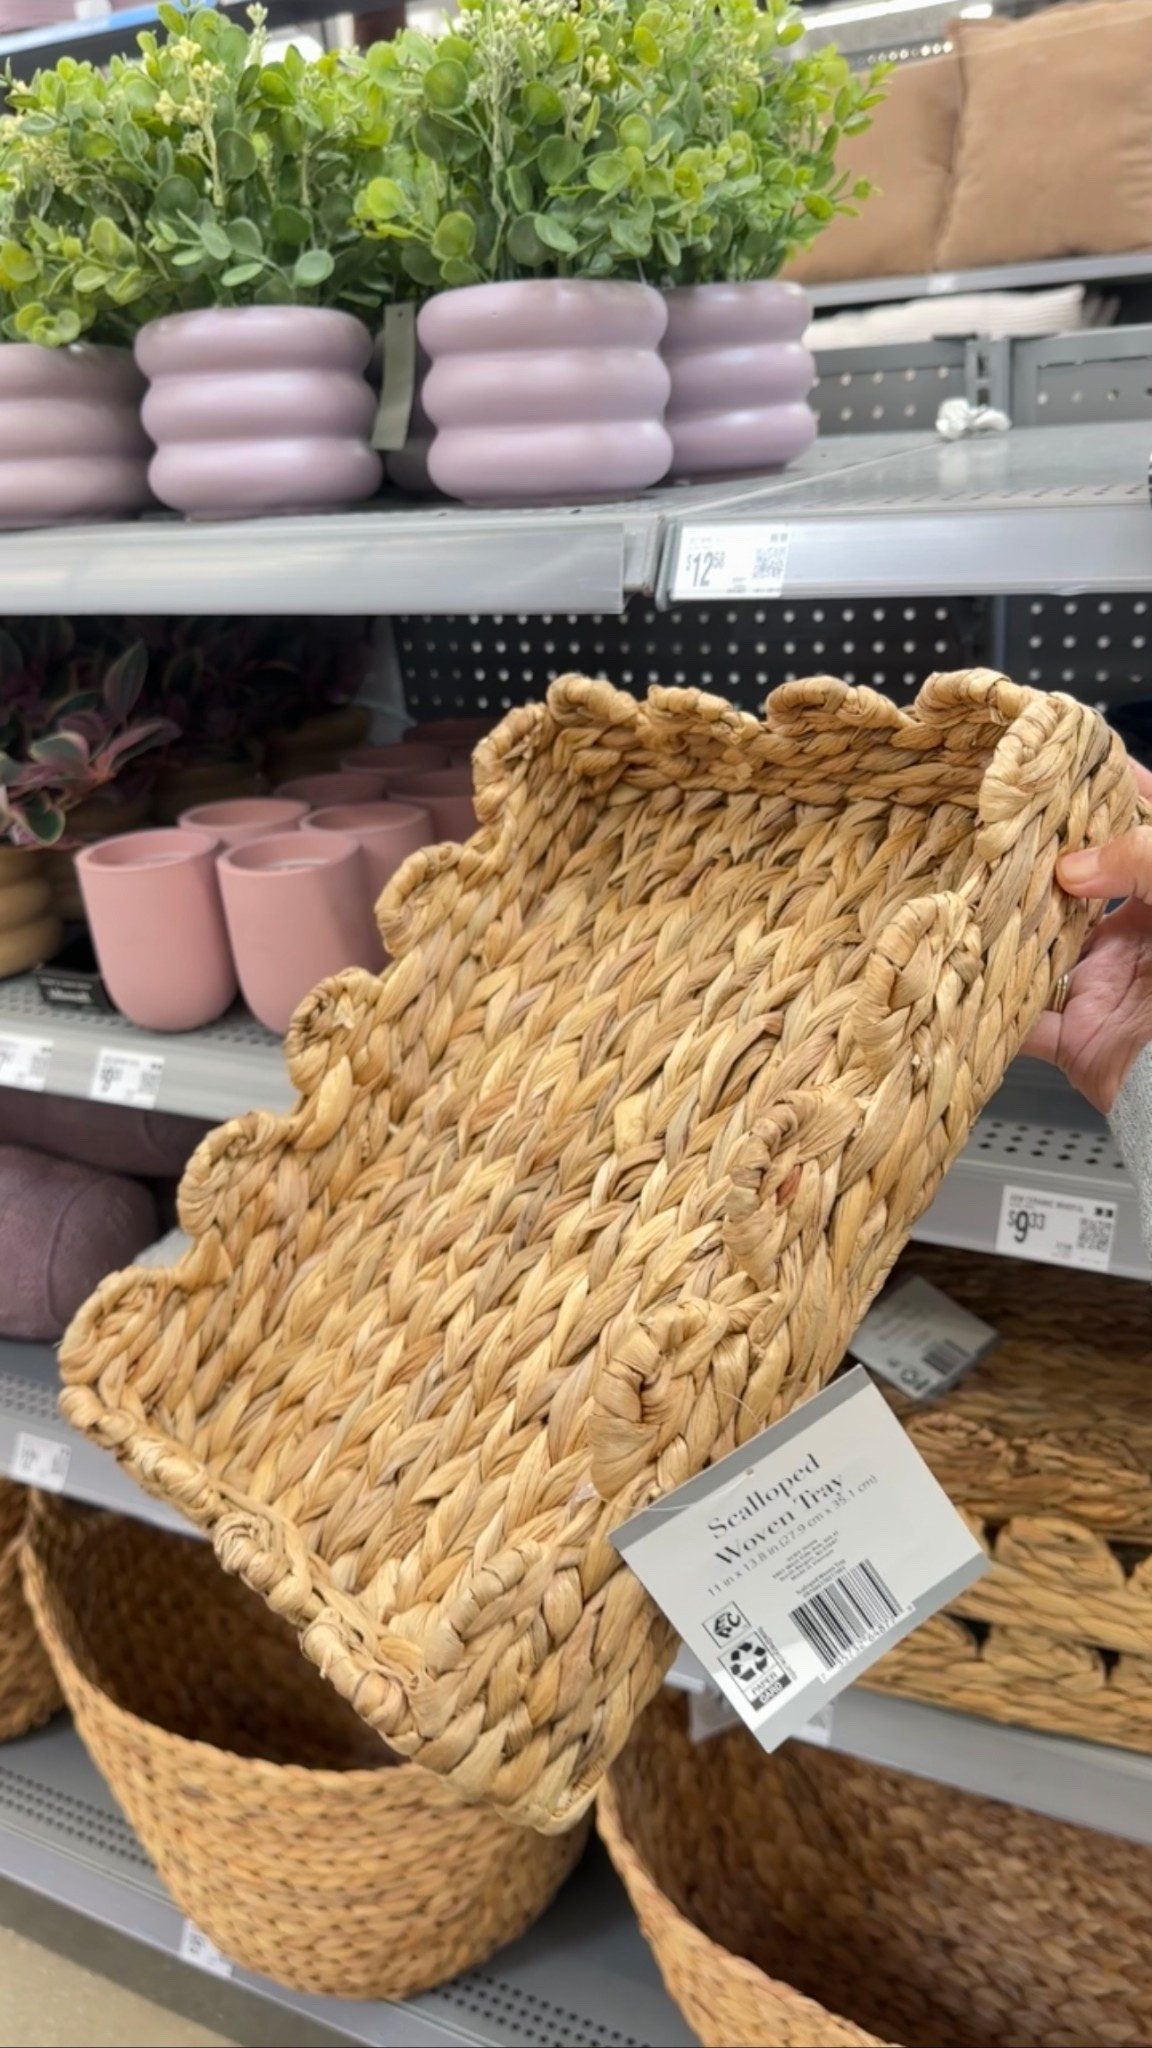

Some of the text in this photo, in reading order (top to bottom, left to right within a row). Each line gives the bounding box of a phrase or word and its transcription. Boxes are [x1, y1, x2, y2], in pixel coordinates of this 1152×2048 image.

[707, 1452, 820, 1539] Scalloped
[707, 1583, 722, 1596] 11
[722, 1575, 735, 1587] in
[742, 1551, 767, 1571] 13.8
[766, 1544, 779, 1556] in
[778, 1523, 806, 1547] (27.9
[806, 1512, 824, 1527] cm
[831, 1489, 855, 1509] 35.1
[856, 1474, 877, 1492] cm)
[714, 1478, 842, 1564] Woven Tray
[751, 1671, 777, 1695] PAPER
[758, 1680, 784, 1704] CARD
